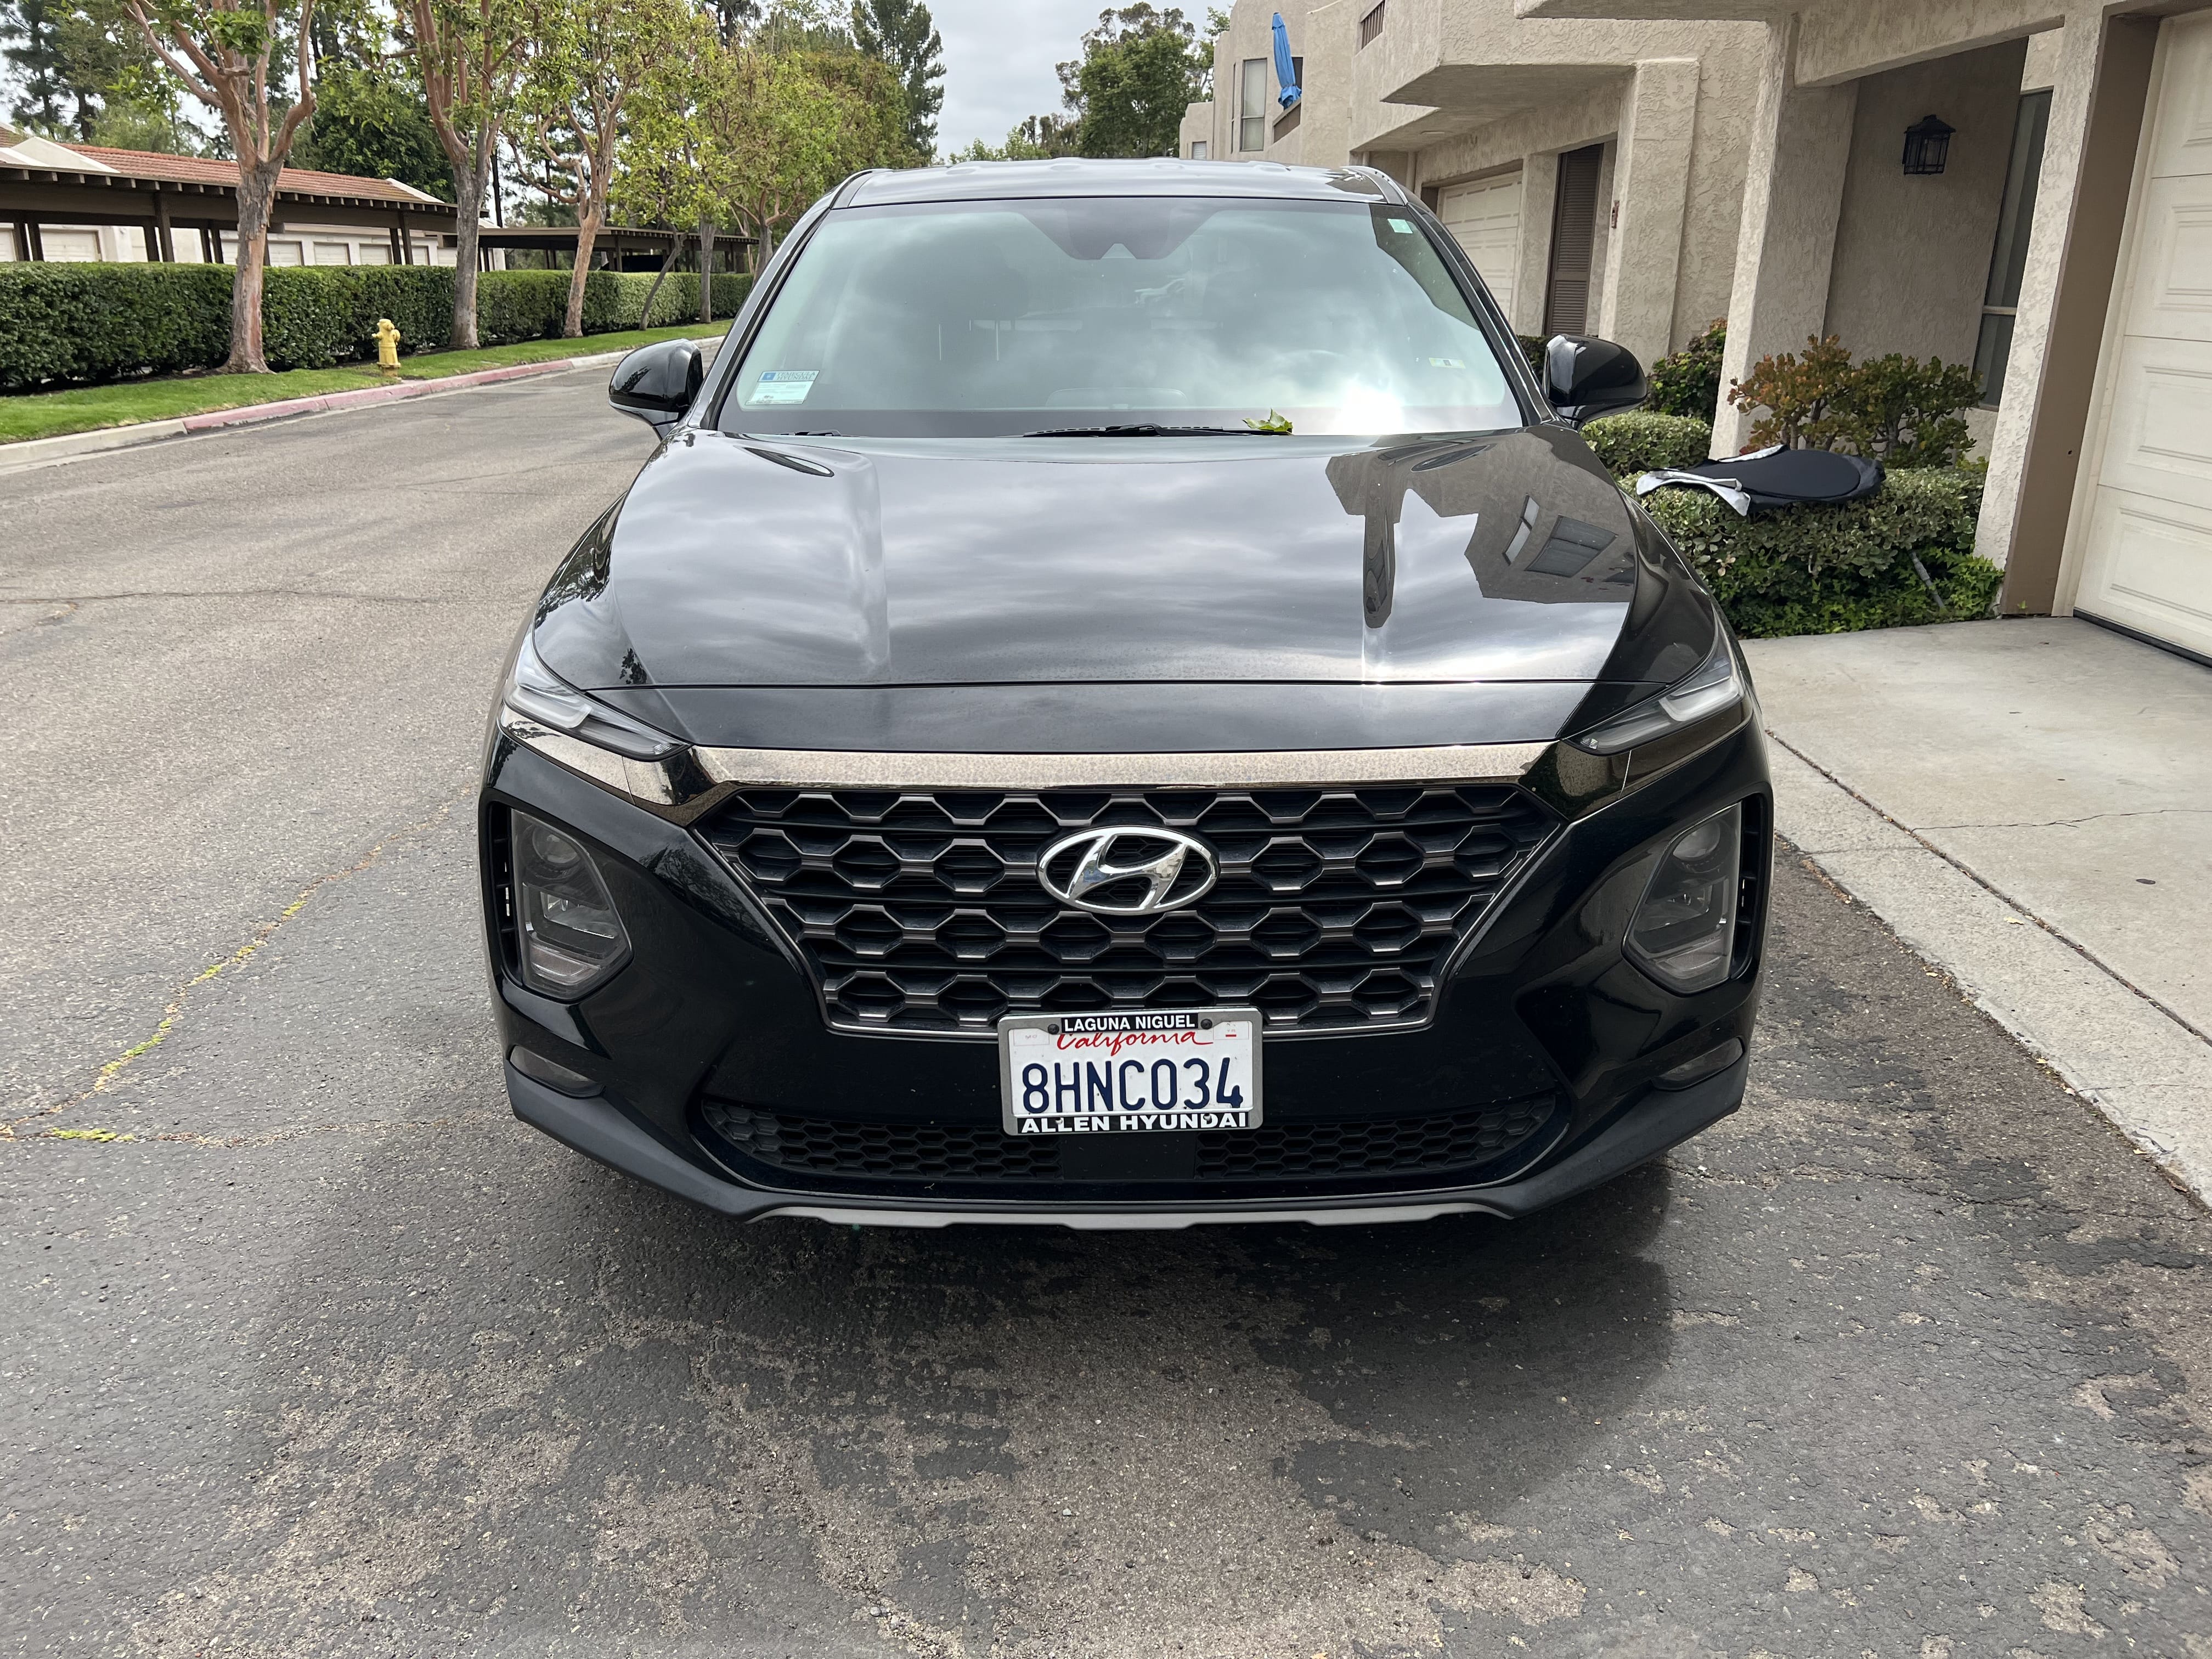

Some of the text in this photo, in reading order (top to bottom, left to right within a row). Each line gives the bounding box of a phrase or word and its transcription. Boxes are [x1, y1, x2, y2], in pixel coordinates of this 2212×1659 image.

[1064, 1014, 1195, 1032] LAGUNA NIGUEL
[1057, 1031, 1214, 1057] California
[1022, 1057, 1244, 1114] 8HNC034
[1022, 1113, 1246, 1133] ALLEN HYUNDAI
